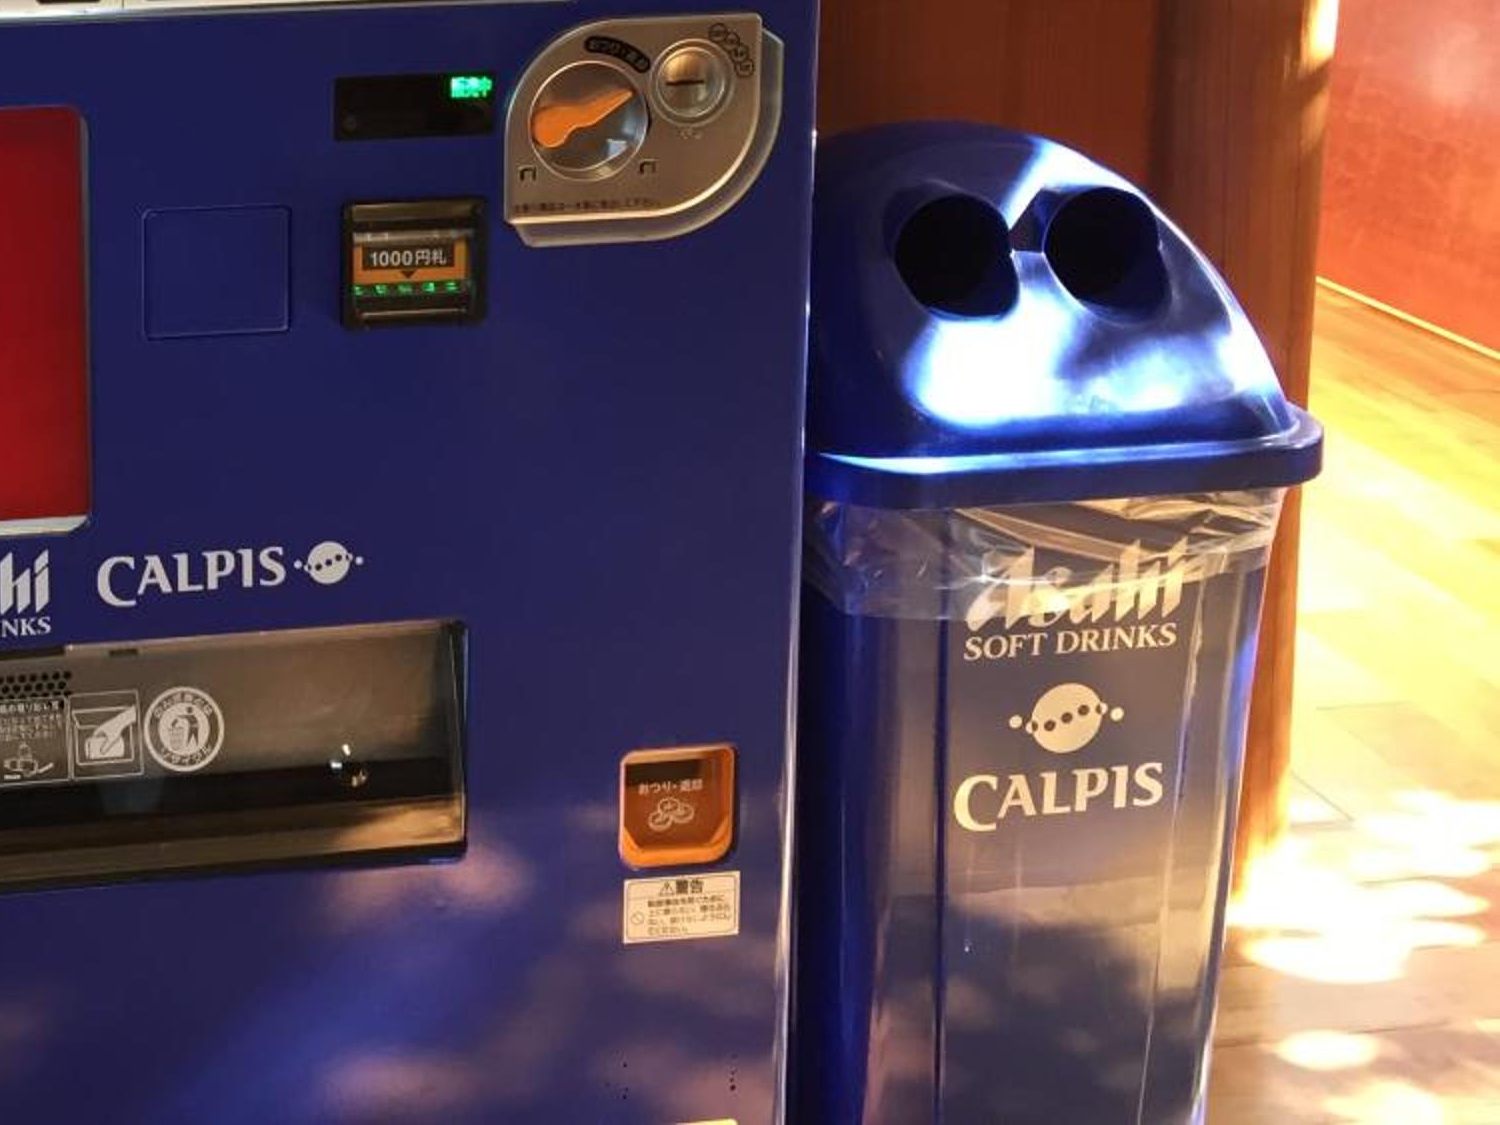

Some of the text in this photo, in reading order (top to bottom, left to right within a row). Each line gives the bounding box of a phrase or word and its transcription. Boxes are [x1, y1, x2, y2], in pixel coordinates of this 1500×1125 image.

[369, 248, 448, 267] 1000円札
[96, 546, 286, 608] CALPIS
[964, 536, 1188, 633] Asahi
[963, 622, 1178, 661] SOFT DRINKS
[953, 761, 1164, 833] CALPIS
